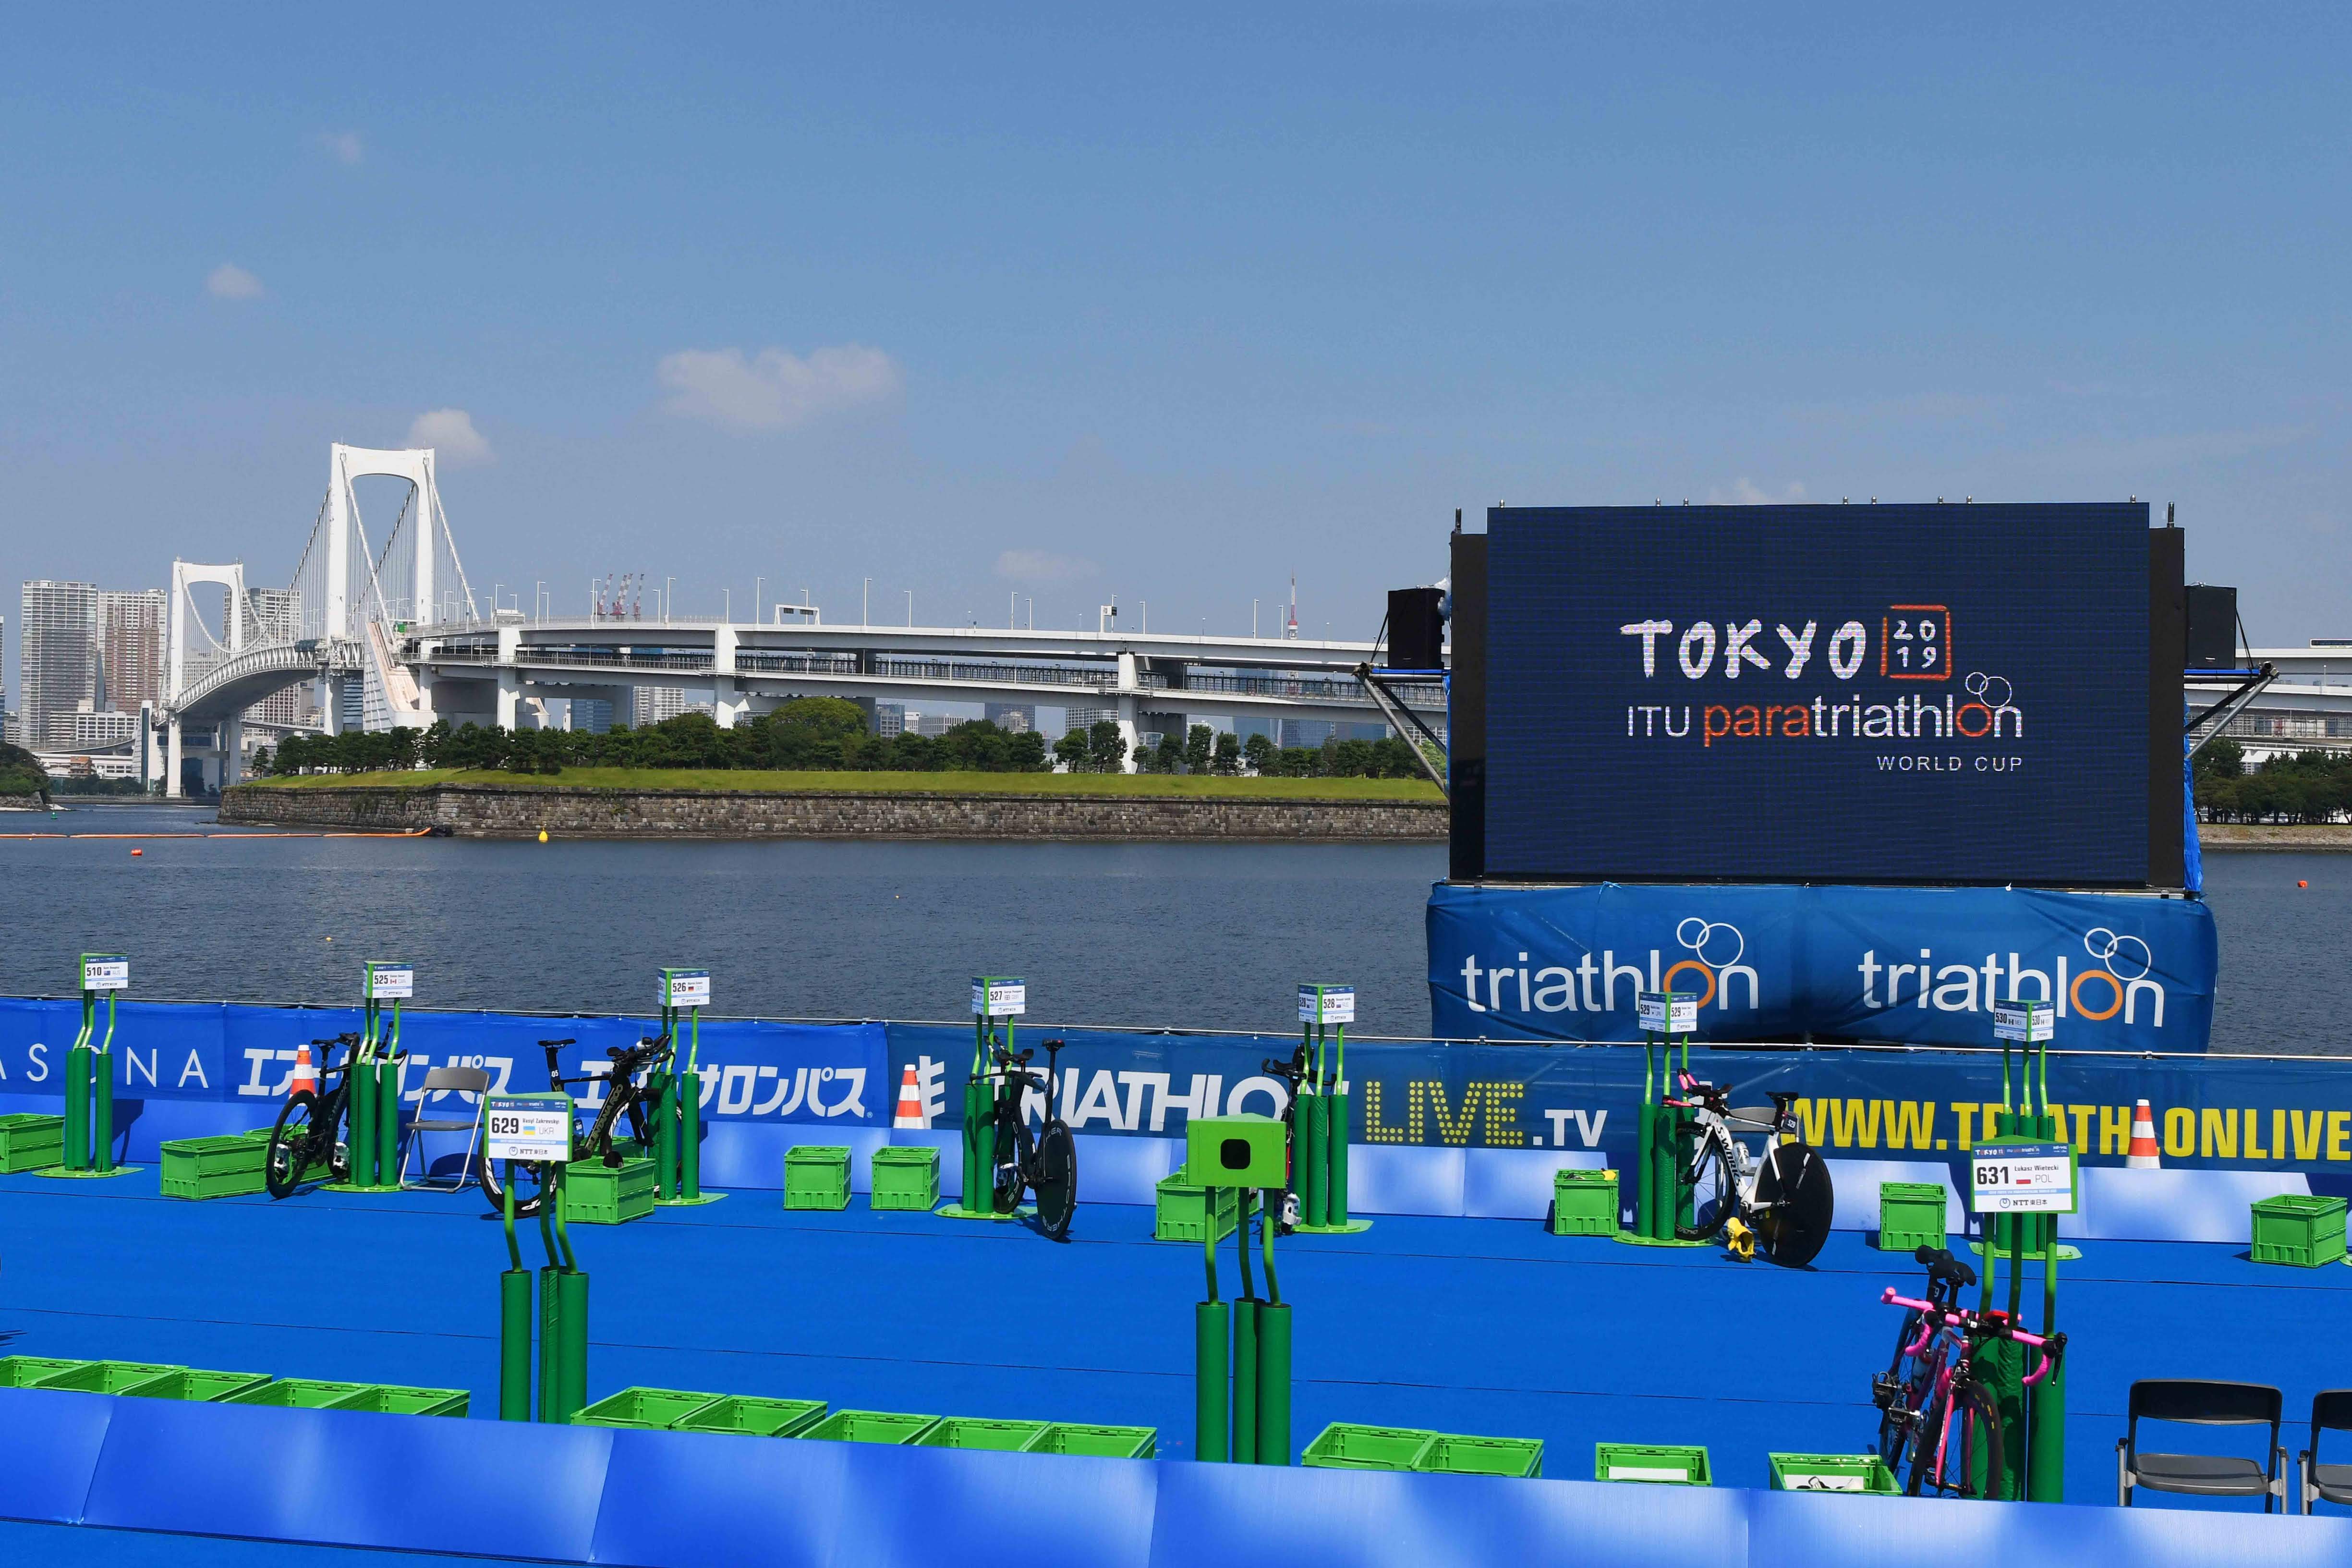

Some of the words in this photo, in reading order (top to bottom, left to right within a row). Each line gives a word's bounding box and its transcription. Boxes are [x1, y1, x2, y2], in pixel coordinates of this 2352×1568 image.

[1620, 619, 1867, 680] TOKYO
[1628, 706, 1690, 737] ITU
[1704, 694, 2023, 747] paratriathlon
[1877, 755, 1962, 771] WORLD
[1975, 755, 2022, 772] CUP
[86, 967, 102, 976] 510
[374, 975, 388, 984] 525
[1461, 949, 1758, 1012] triathlon
[672, 982, 687, 992] 526
[1858, 949, 2164, 1027] triathlon
[990, 991, 1003, 1001] 527
[1323, 998, 1335, 1009] 528
[1640, 1004, 1650, 1015] 529
[1671, 1007, 1681, 1017] 529
[1996, 1012, 2007, 1023] 530
[0, 1043, 209, 1088] SNA
[984, 1066, 1349, 1132] TRIATHLO
[491, 1117, 519, 1134] 629
[1976, 1166, 2009, 1185] 631
[2035, 1174, 2053, 1183] POL
